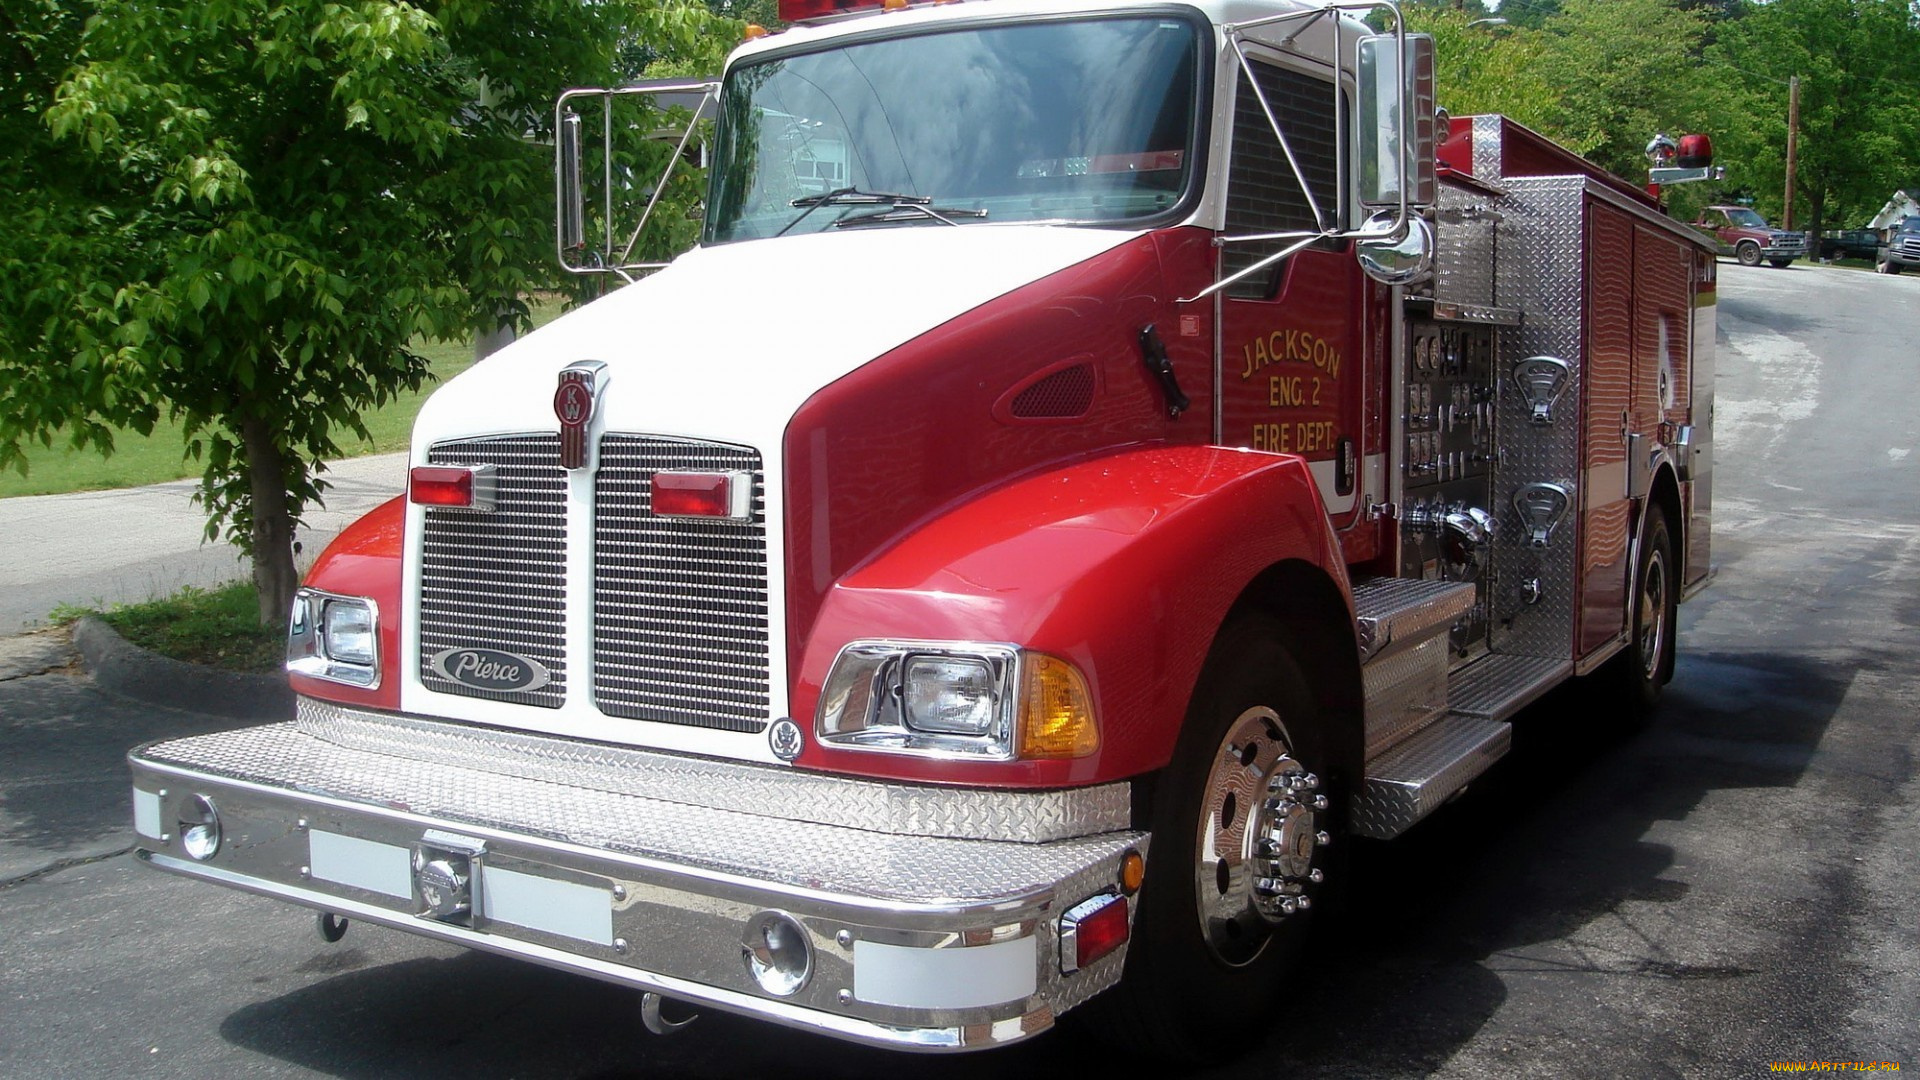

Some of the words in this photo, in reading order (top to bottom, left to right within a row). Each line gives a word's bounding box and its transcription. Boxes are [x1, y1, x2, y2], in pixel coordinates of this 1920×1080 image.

[1242, 330, 1341, 379] JACKSON
[1270, 376, 1306, 406] ENG.
[1312, 377, 1321, 406] 2
[1254, 422, 1290, 452] FIRE
[1296, 421, 1335, 452] DEPT.
[455, 652, 521, 682] Pierce
